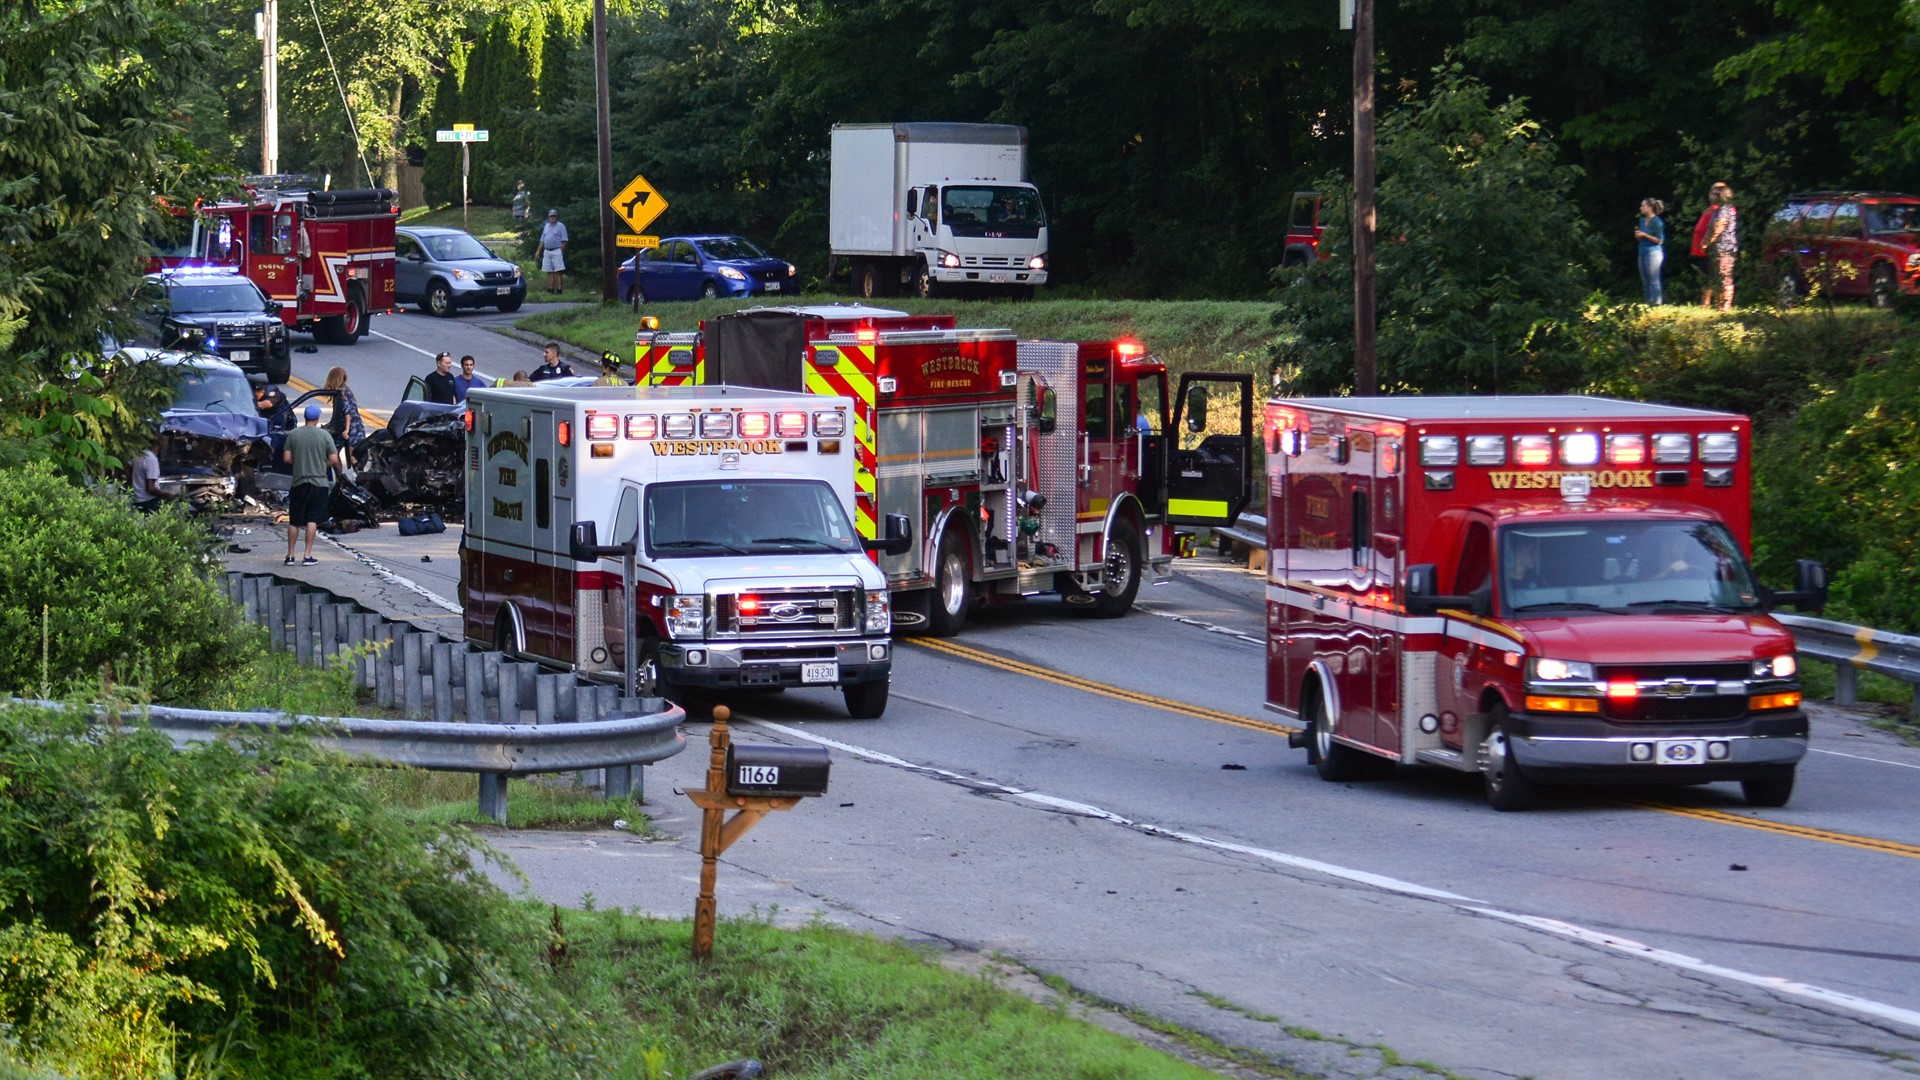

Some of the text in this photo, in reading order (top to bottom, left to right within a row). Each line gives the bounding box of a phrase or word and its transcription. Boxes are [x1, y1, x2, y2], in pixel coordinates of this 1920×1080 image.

[618, 237, 646, 246] Methodist
[258, 263, 285, 271] ENGINE
[267, 271, 277, 280] 2
[384, 279, 395, 292] E2
[921, 356, 980, 376] WESTBROOK
[1488, 470, 1654, 489] WESTROOK
[742, 767, 776, 783] 1166
